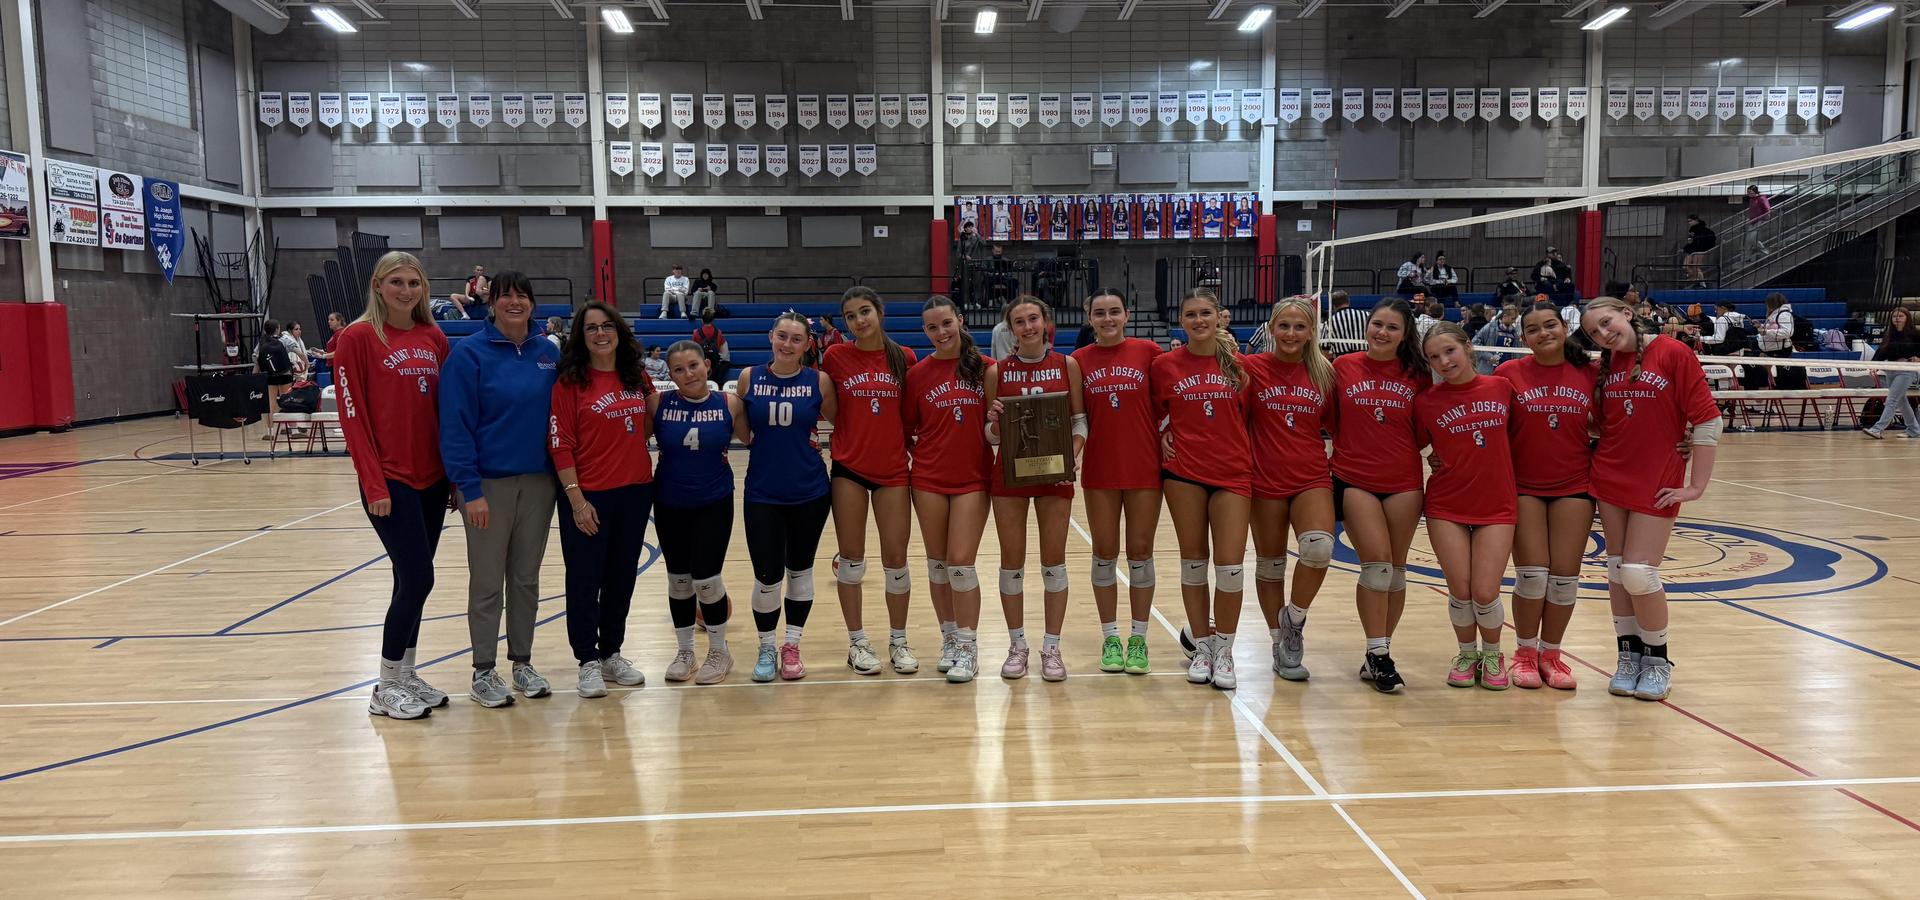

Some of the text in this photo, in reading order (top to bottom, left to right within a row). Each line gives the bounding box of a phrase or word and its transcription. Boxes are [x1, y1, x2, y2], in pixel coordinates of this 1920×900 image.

[115, 232, 144, 245] Go Spartans
[383, 348, 437, 369] SAINT JOSE
[398, 368, 439, 376] VOLLEYBA
[843, 372, 902, 390] SAINT JOSE
[1004, 368, 1062, 383] SAINT JOSEPH
[1084, 366, 1144, 389] SAINT JOSEPH
[1604, 370, 1669, 391] AINT SEPH
[338, 366, 356, 418] COACH
[753, 384, 812, 398] SAINT JOSEPH
[925, 381, 951, 403] SAINT
[1090, 383, 1138, 394] VOLLEYBALL
[1173, 374, 1200, 394] SAINT
[1346, 380, 1415, 402] SAINT JOSEPH
[591, 390, 645, 414] SAINT JOSE
[935, 398, 980, 408] VOLLEYBALL
[1183, 392, 1233, 400] VOLLEYBALL
[1258, 386, 1323, 406] SAINT JOSEPH
[1354, 398, 1406, 409] VOLLEYBALL
[1516, 386, 1590, 407] SAINT JOSEPH
[1604, 390, 1657, 400] VOLLEYBALL
[662, 408, 724, 422] SAINT JOSEPH
[768, 401, 793, 427] 10
[1266, 402, 1316, 413] VOLLEYBALL
[1436, 401, 1507, 428] SAINT JOSEPH
[1526, 404, 1582, 414] VOLLEYBALL
[1449, 418, 1504, 434] VOLLEYBALL
[683, 427, 699, 450] 4
